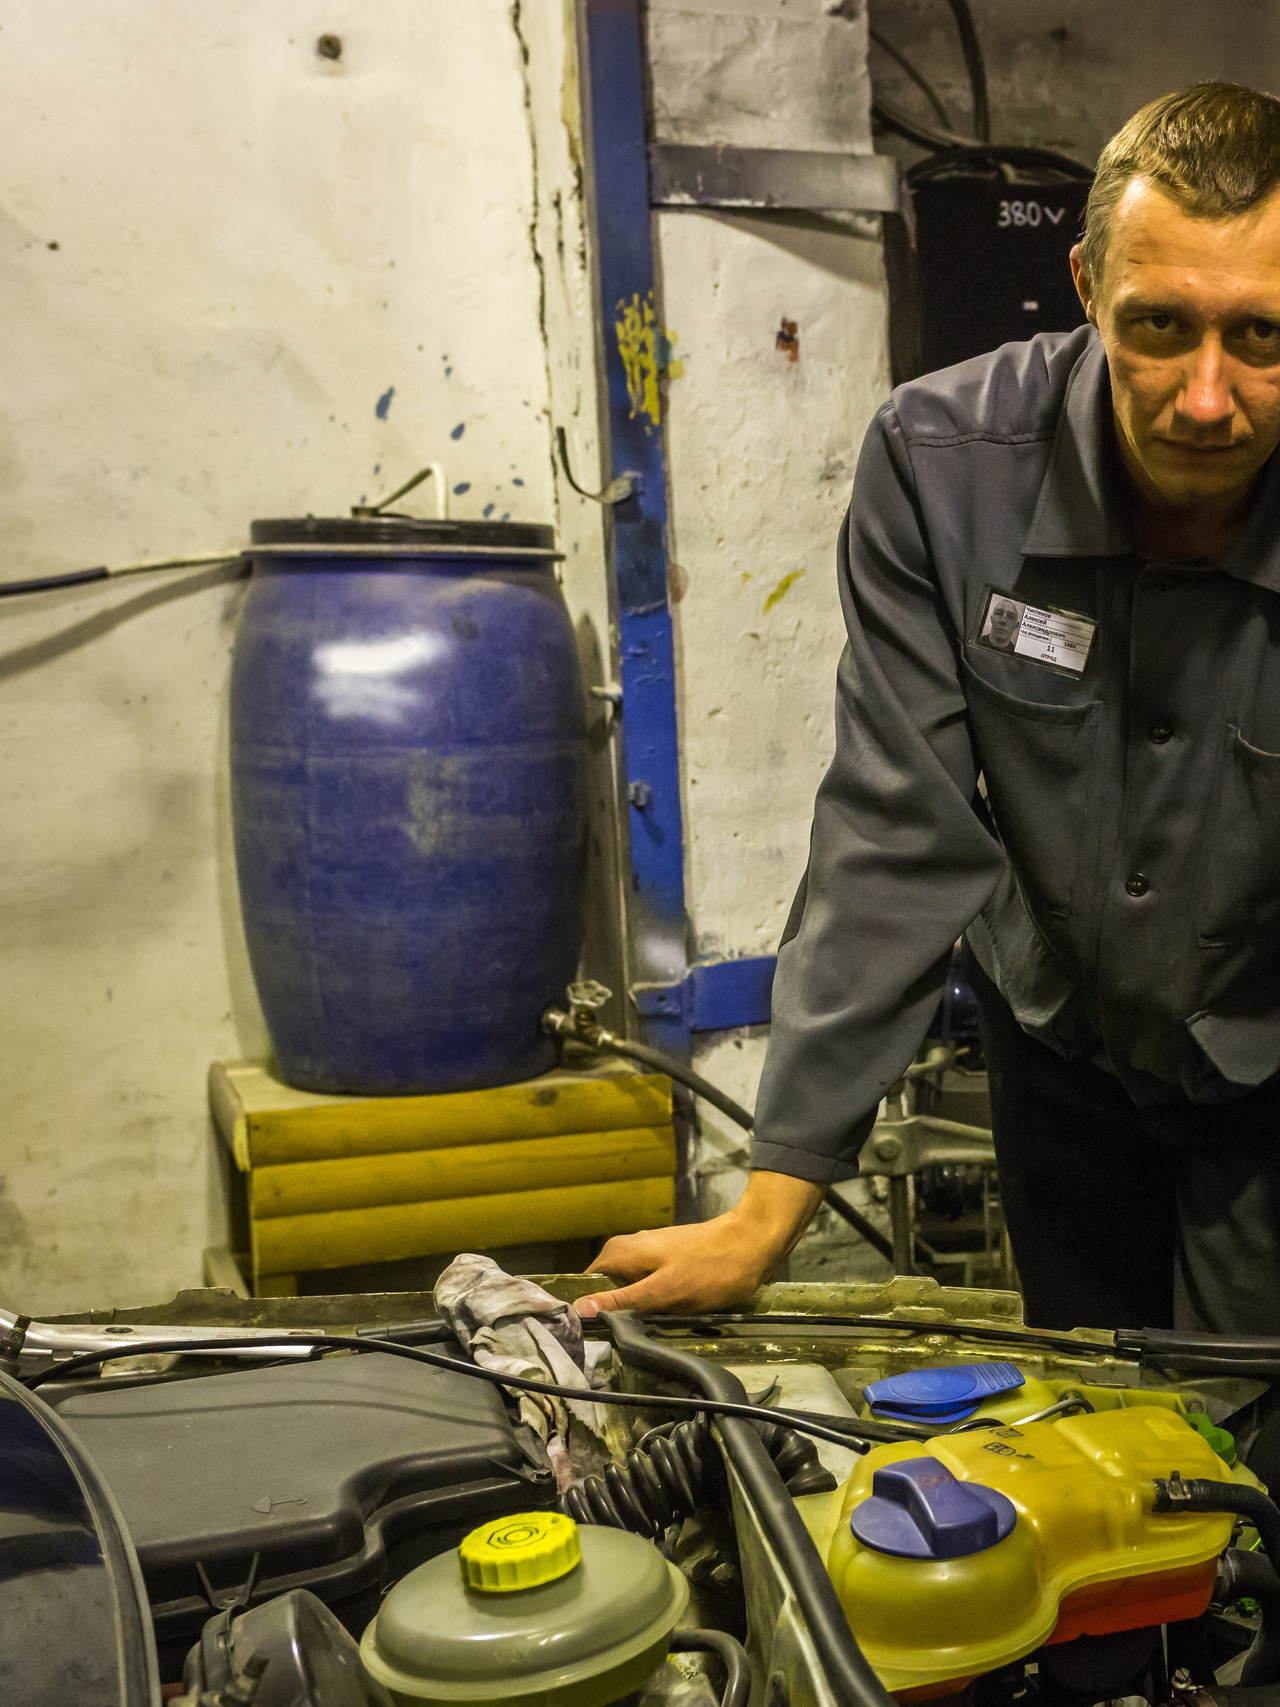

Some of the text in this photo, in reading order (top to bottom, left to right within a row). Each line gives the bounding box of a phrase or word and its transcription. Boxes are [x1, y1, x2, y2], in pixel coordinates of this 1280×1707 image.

[997, 200, 1042, 227] 380
[1026, 606, 1052, 619] Чистяков
[1023, 614, 1047, 625] Алексей
[1022, 621, 1066, 638] Александрович
[1046, 645, 1055, 653] 11
